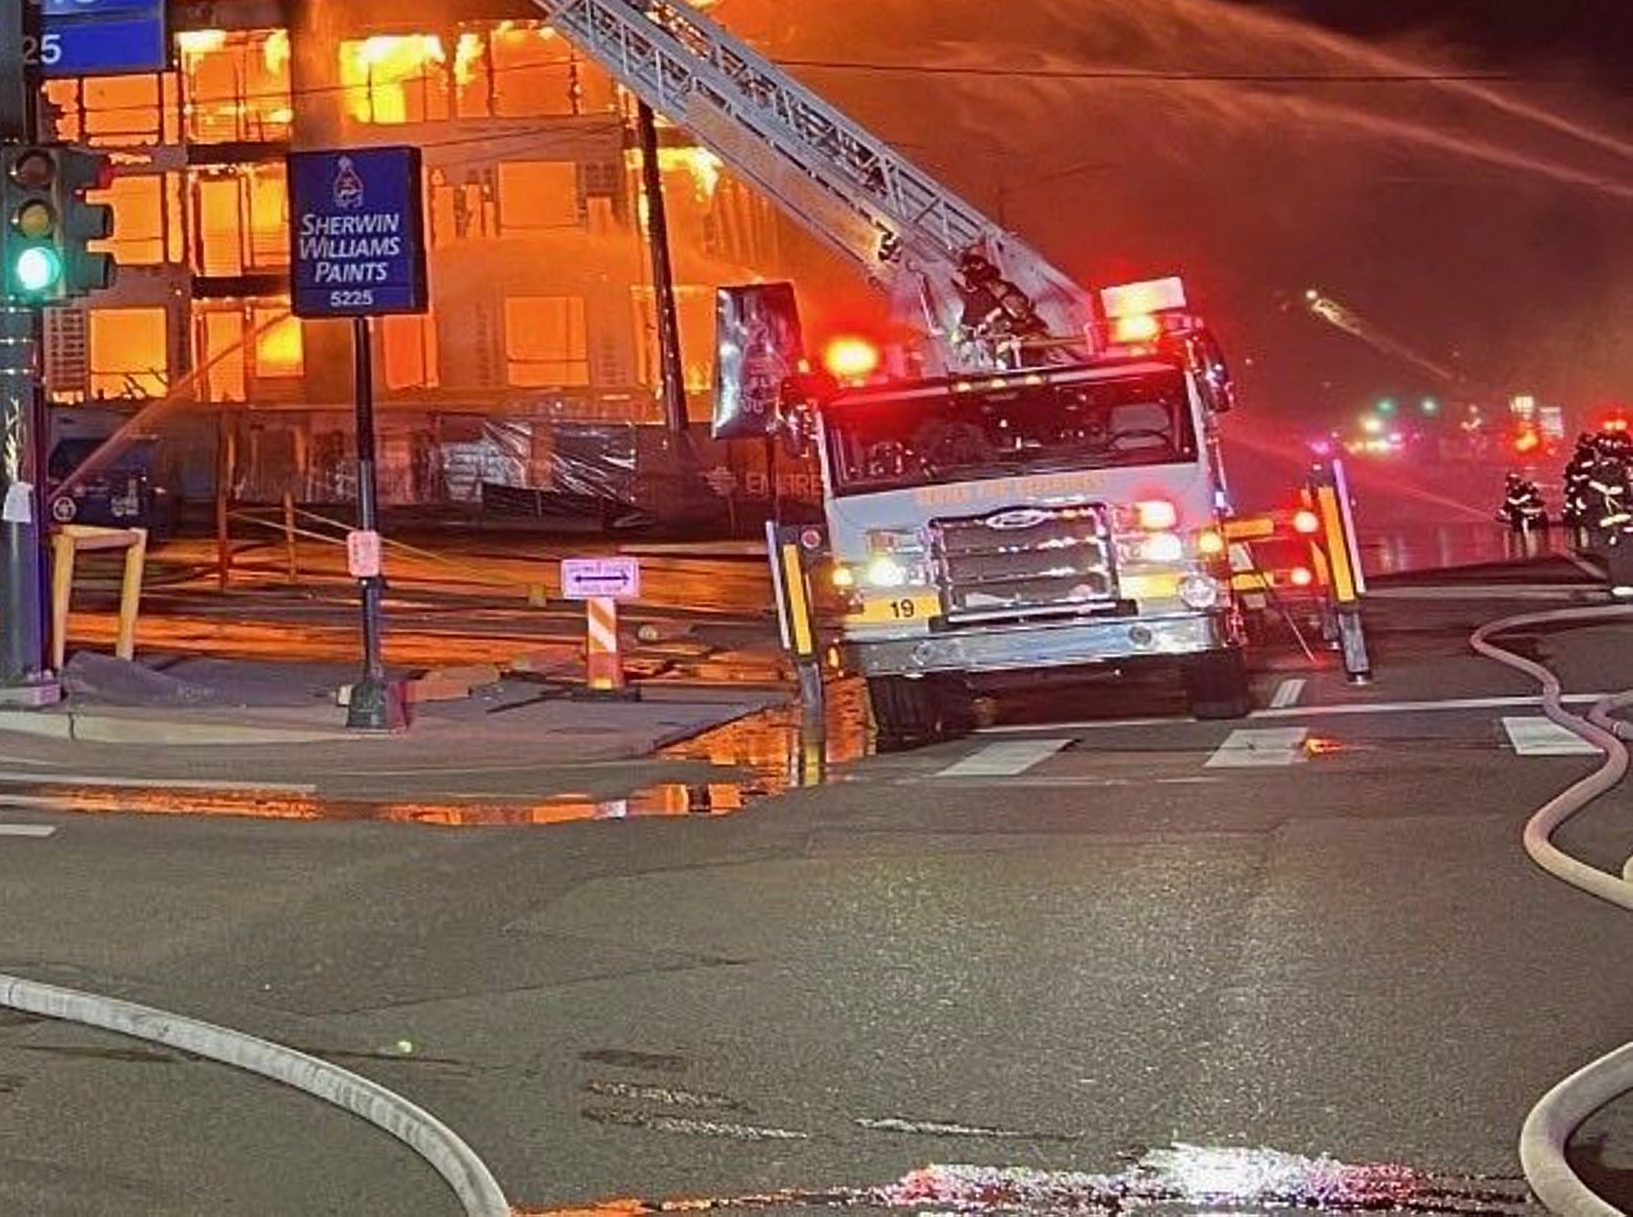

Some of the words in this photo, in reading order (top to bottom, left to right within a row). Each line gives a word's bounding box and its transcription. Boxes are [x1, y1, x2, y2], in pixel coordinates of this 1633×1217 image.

[301, 213, 400, 236] SHERWIN
[299, 236, 401, 260] WILLIAMS
[315, 261, 389, 283] PAINTS
[330, 289, 373, 307] 5225
[890, 598, 915, 618] 19
